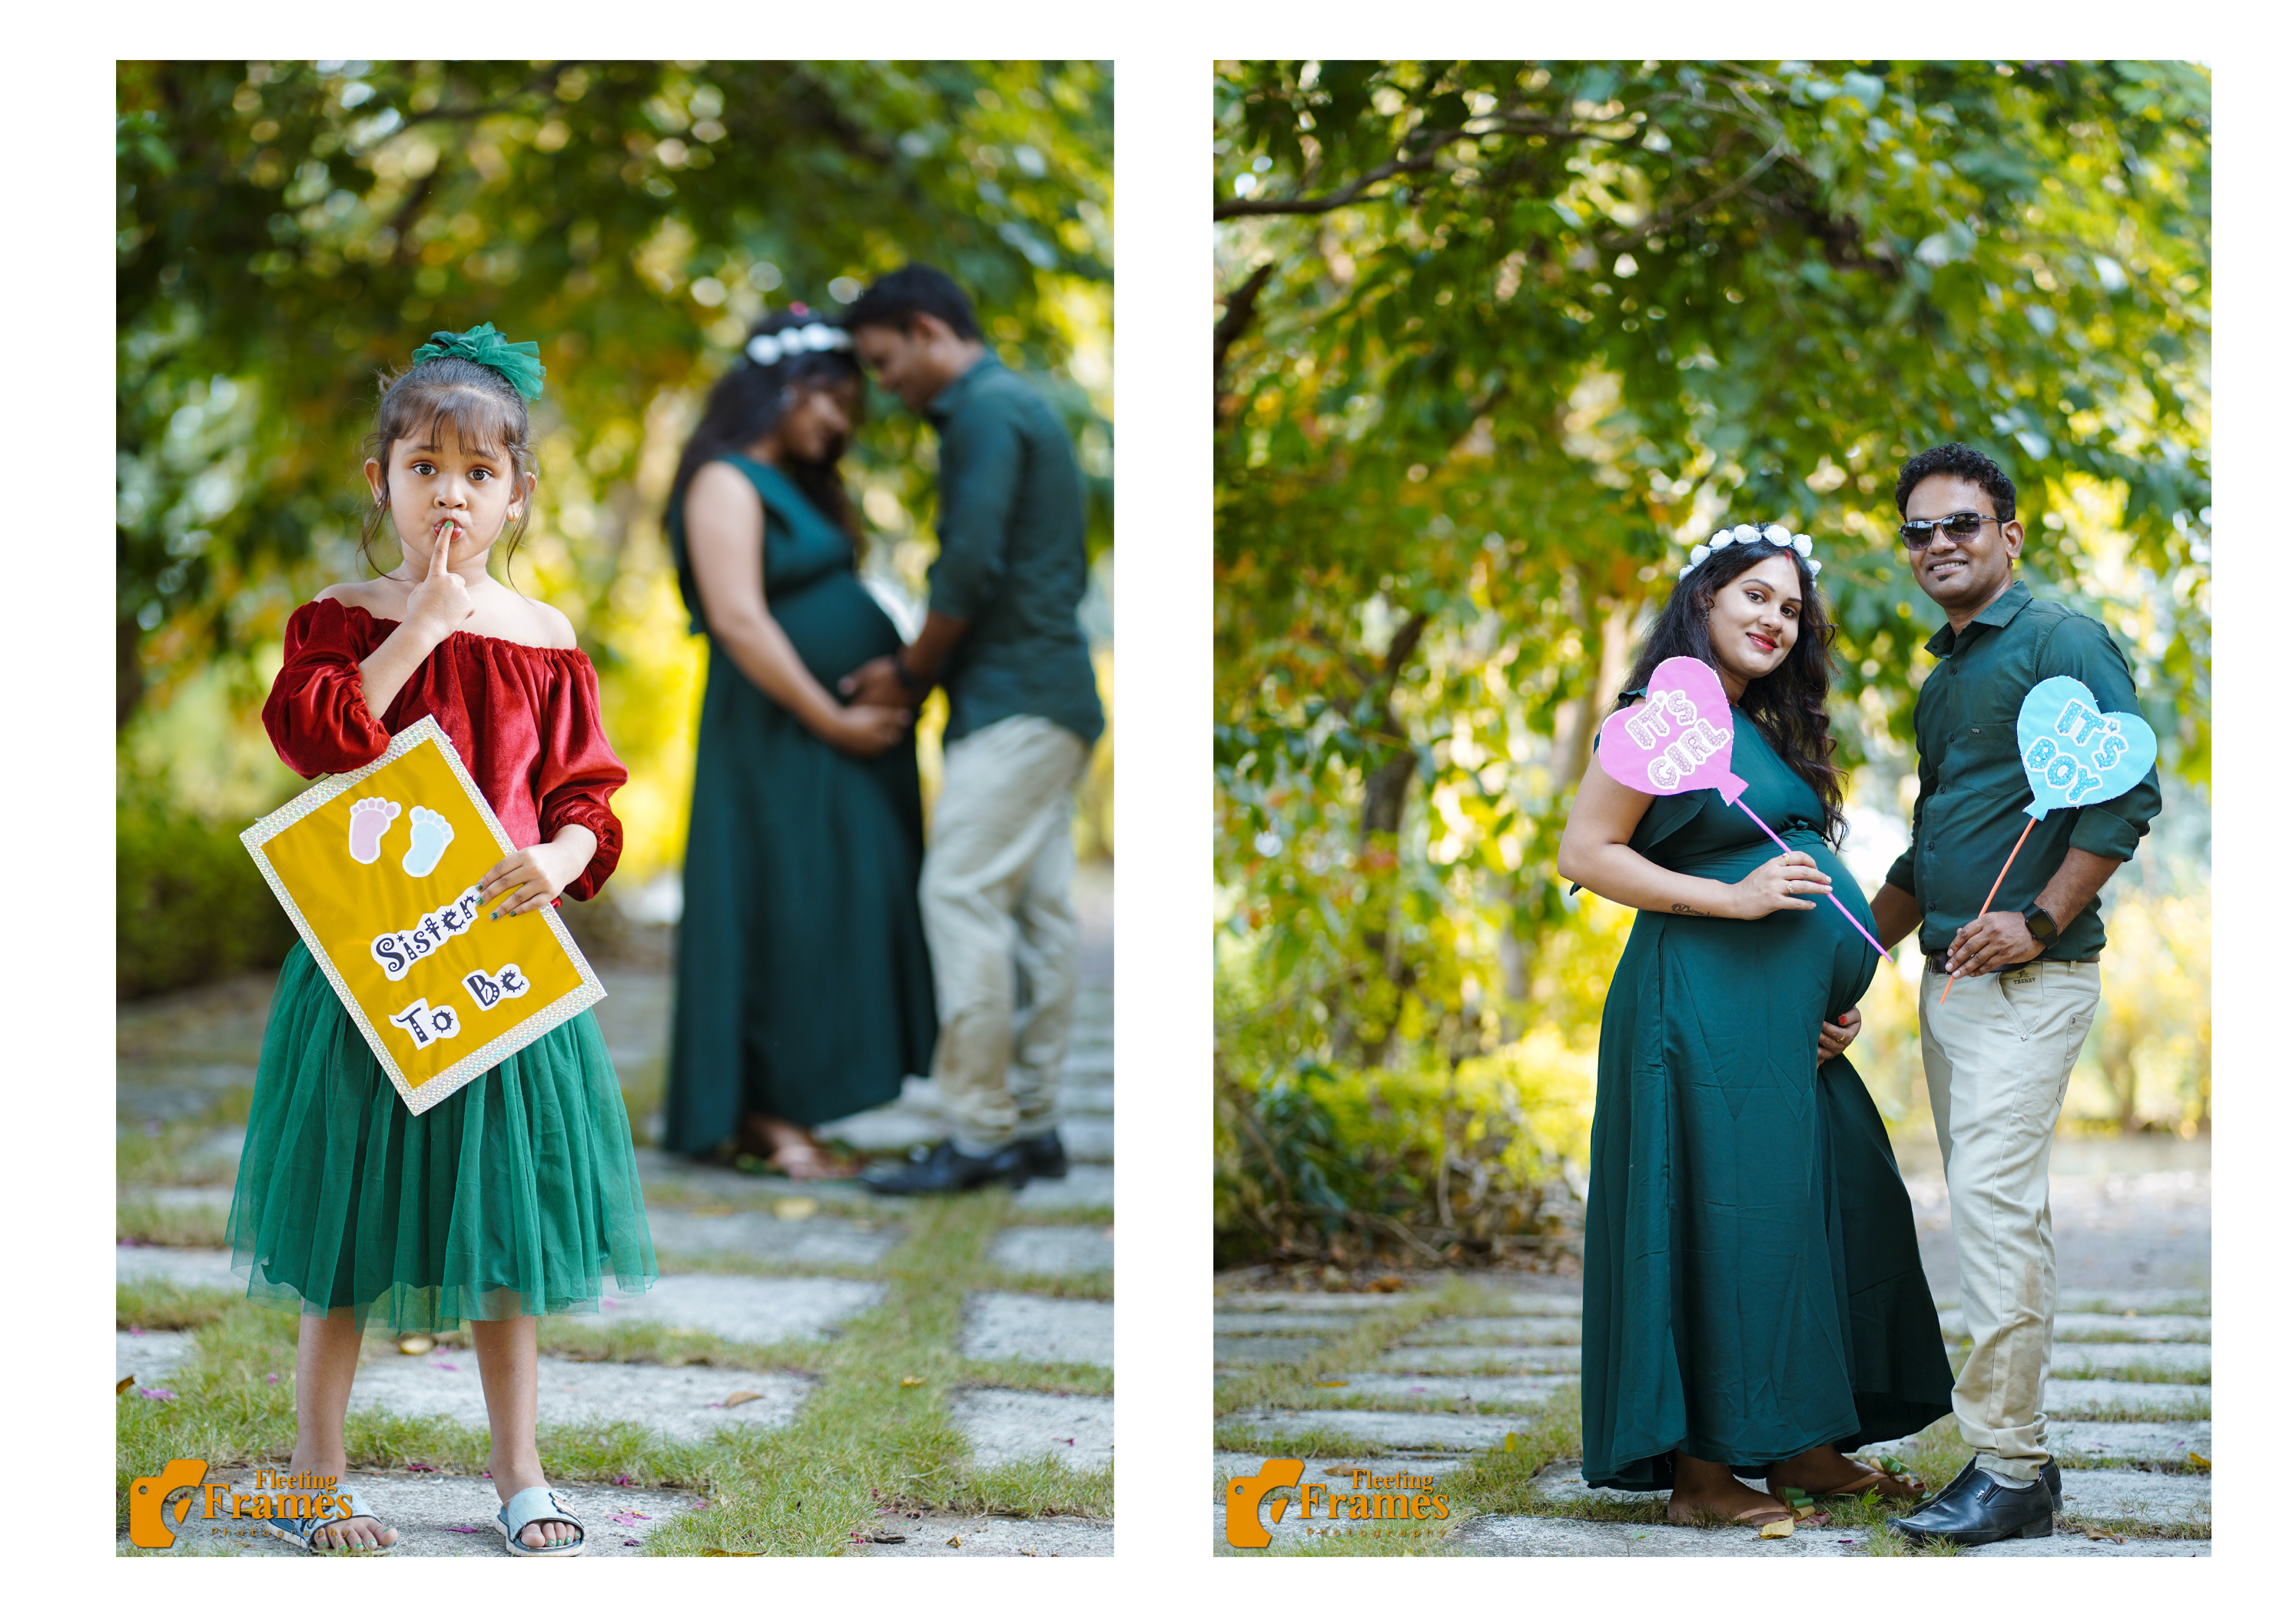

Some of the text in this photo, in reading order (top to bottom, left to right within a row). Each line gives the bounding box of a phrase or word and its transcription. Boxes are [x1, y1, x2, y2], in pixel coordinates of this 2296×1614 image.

[1627, 692, 1694, 747] IT'S
[1650, 719, 1728, 787] GIRL
[2056, 701, 2126, 768] IT'S
[2026, 738, 2101, 802] BOY
[376, 895, 476, 972] Sister
[396, 970, 525, 1043] To Be
